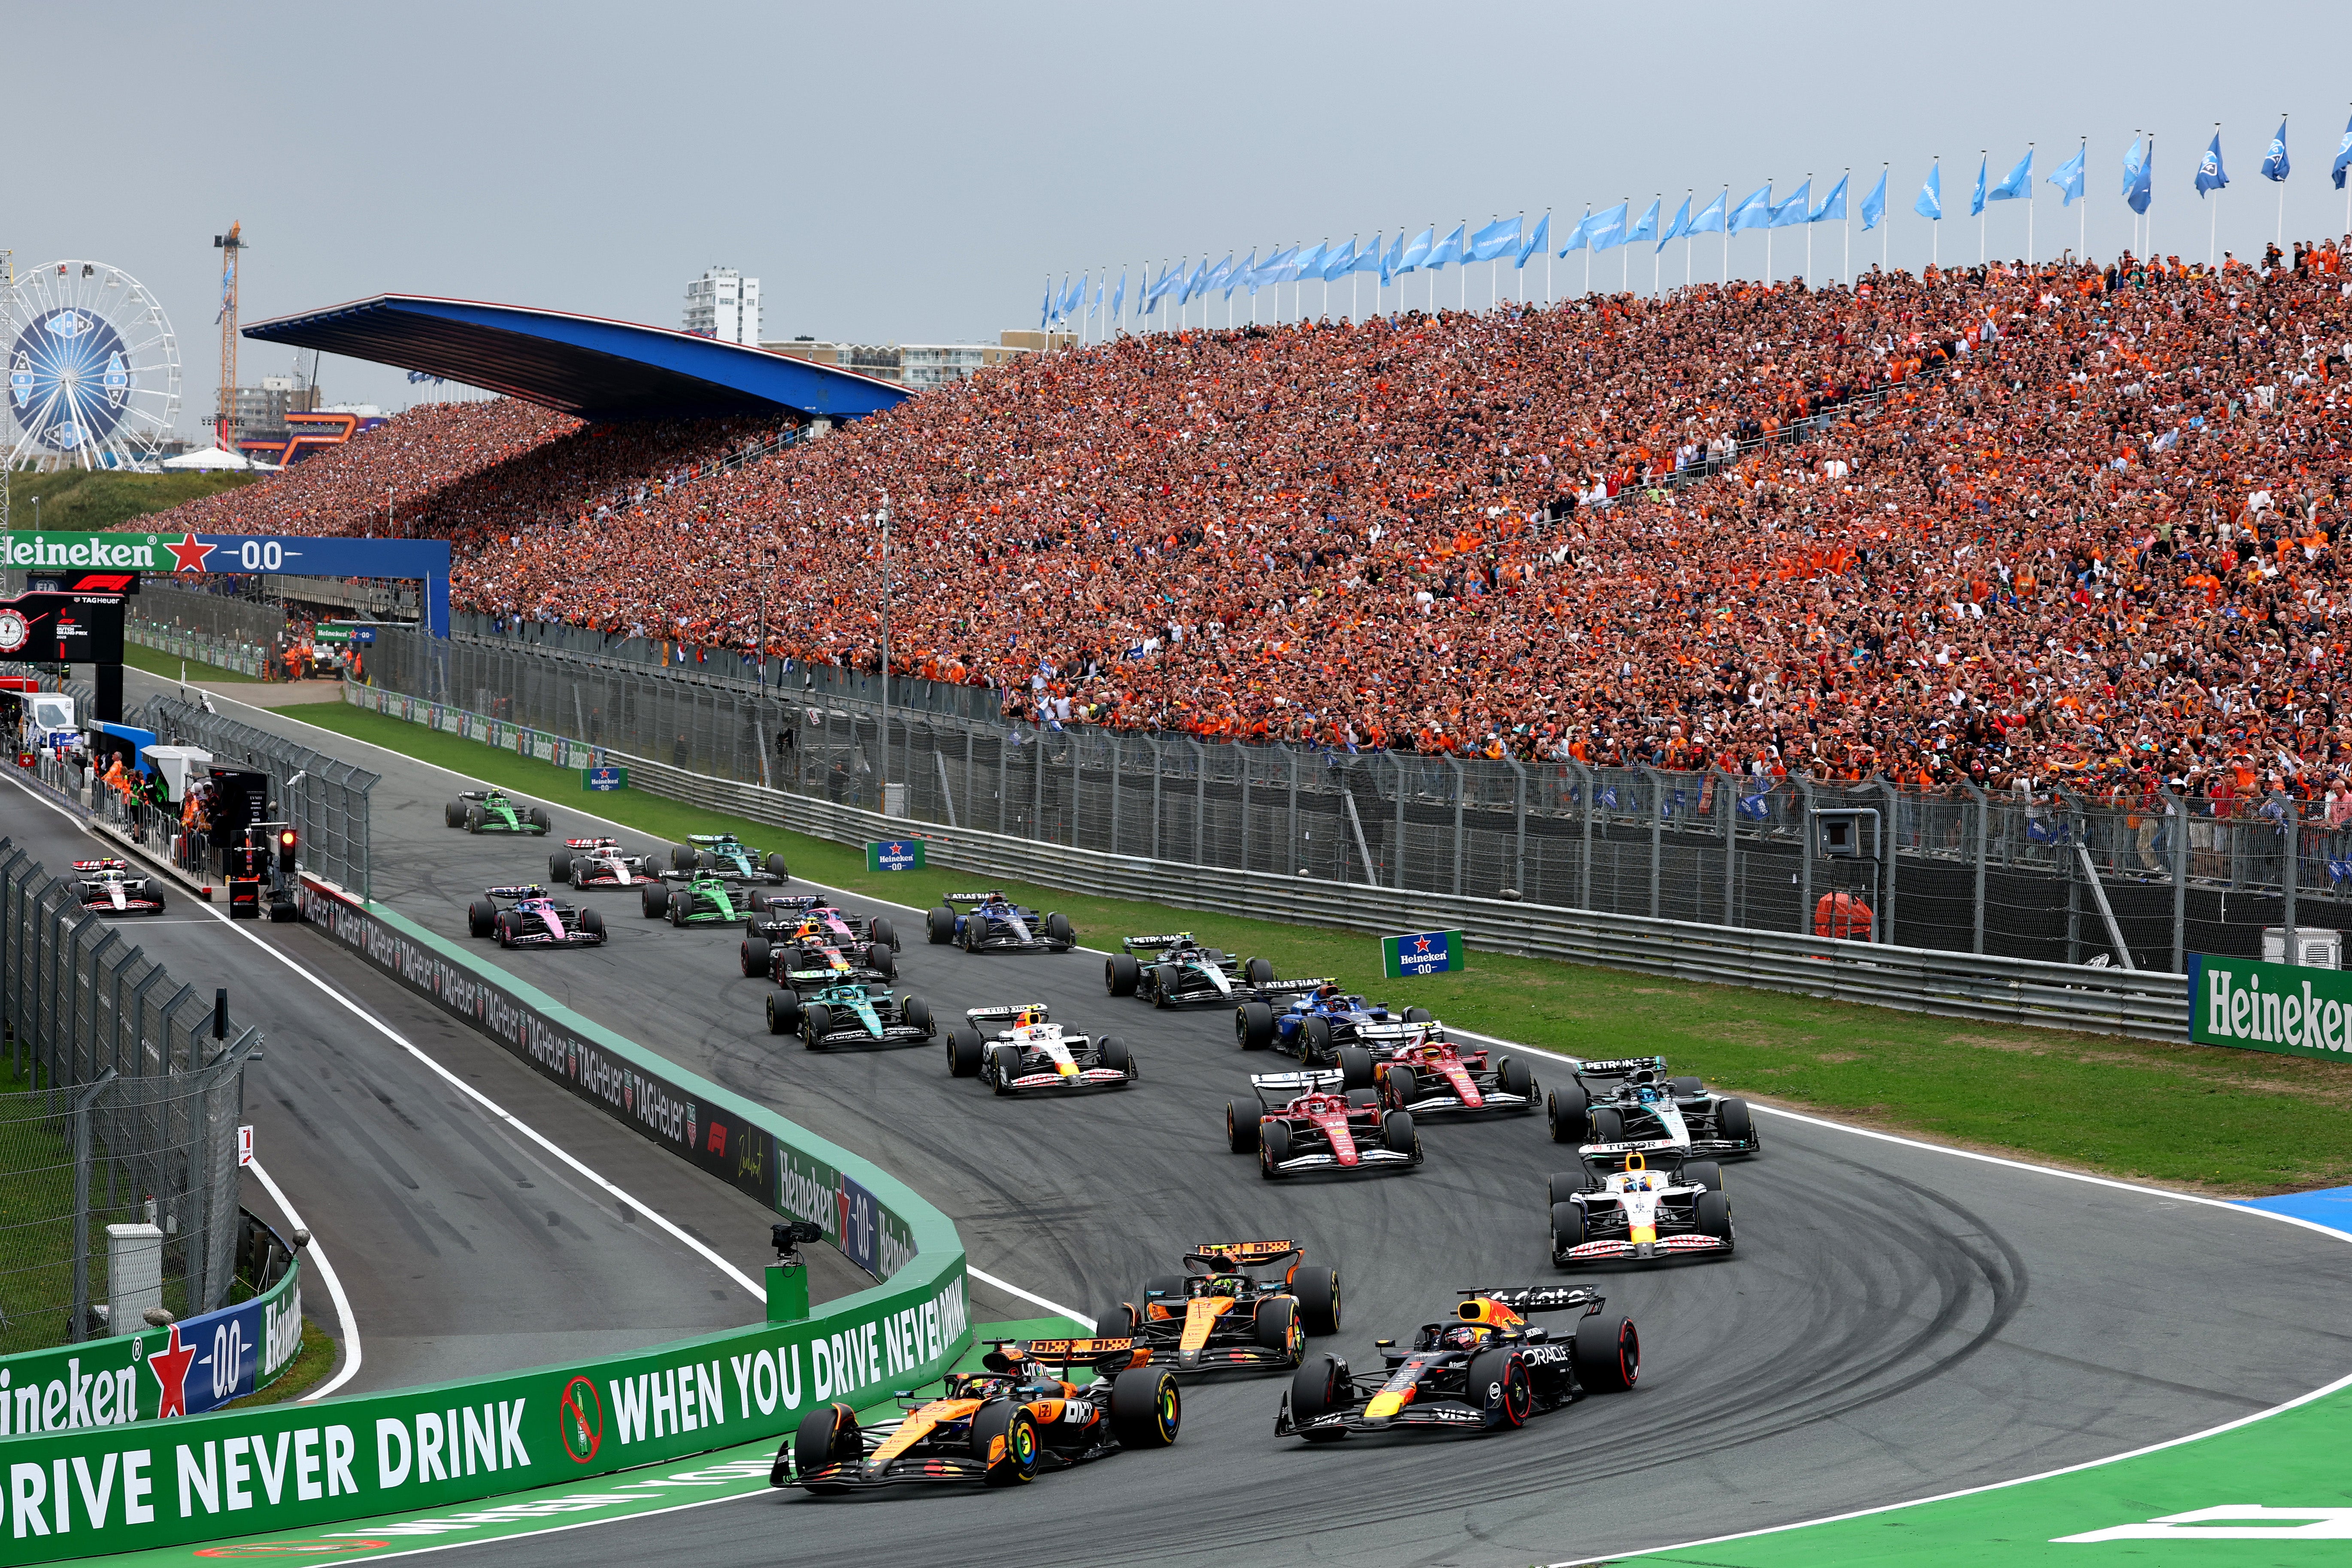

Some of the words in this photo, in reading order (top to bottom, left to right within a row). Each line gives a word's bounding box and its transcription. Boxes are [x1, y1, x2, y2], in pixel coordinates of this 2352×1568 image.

[1400, 952, 1447, 965] Heineken
[1266, 978, 1321, 988] ATLASSIAN
[1016, 1074, 1055, 1086] HUGO
[1088, 1069, 1121, 1078] HUGO
[779, 1149, 835, 1236] Heineken
[1574, 1241, 1622, 1255] HUGO
[1668, 1236, 1716, 1247] HUGO
[212, 1320, 241, 1399] 0.0
[1522, 1346, 1568, 1367] ORACLE
[0, 1449, 155, 1538] RIVE
[176, 1424, 359, 1517] NEVER
[376, 1397, 532, 1489] DRINK
[609, 1359, 725, 1445] WHEN
[730, 1344, 801, 1419] YOU
[811, 1321, 881, 1402] DRIVE
[884, 1299, 943, 1377] NEVER
[939, 1274, 967, 1351] DRINK
[1433, 1408, 1481, 1420] VISA
